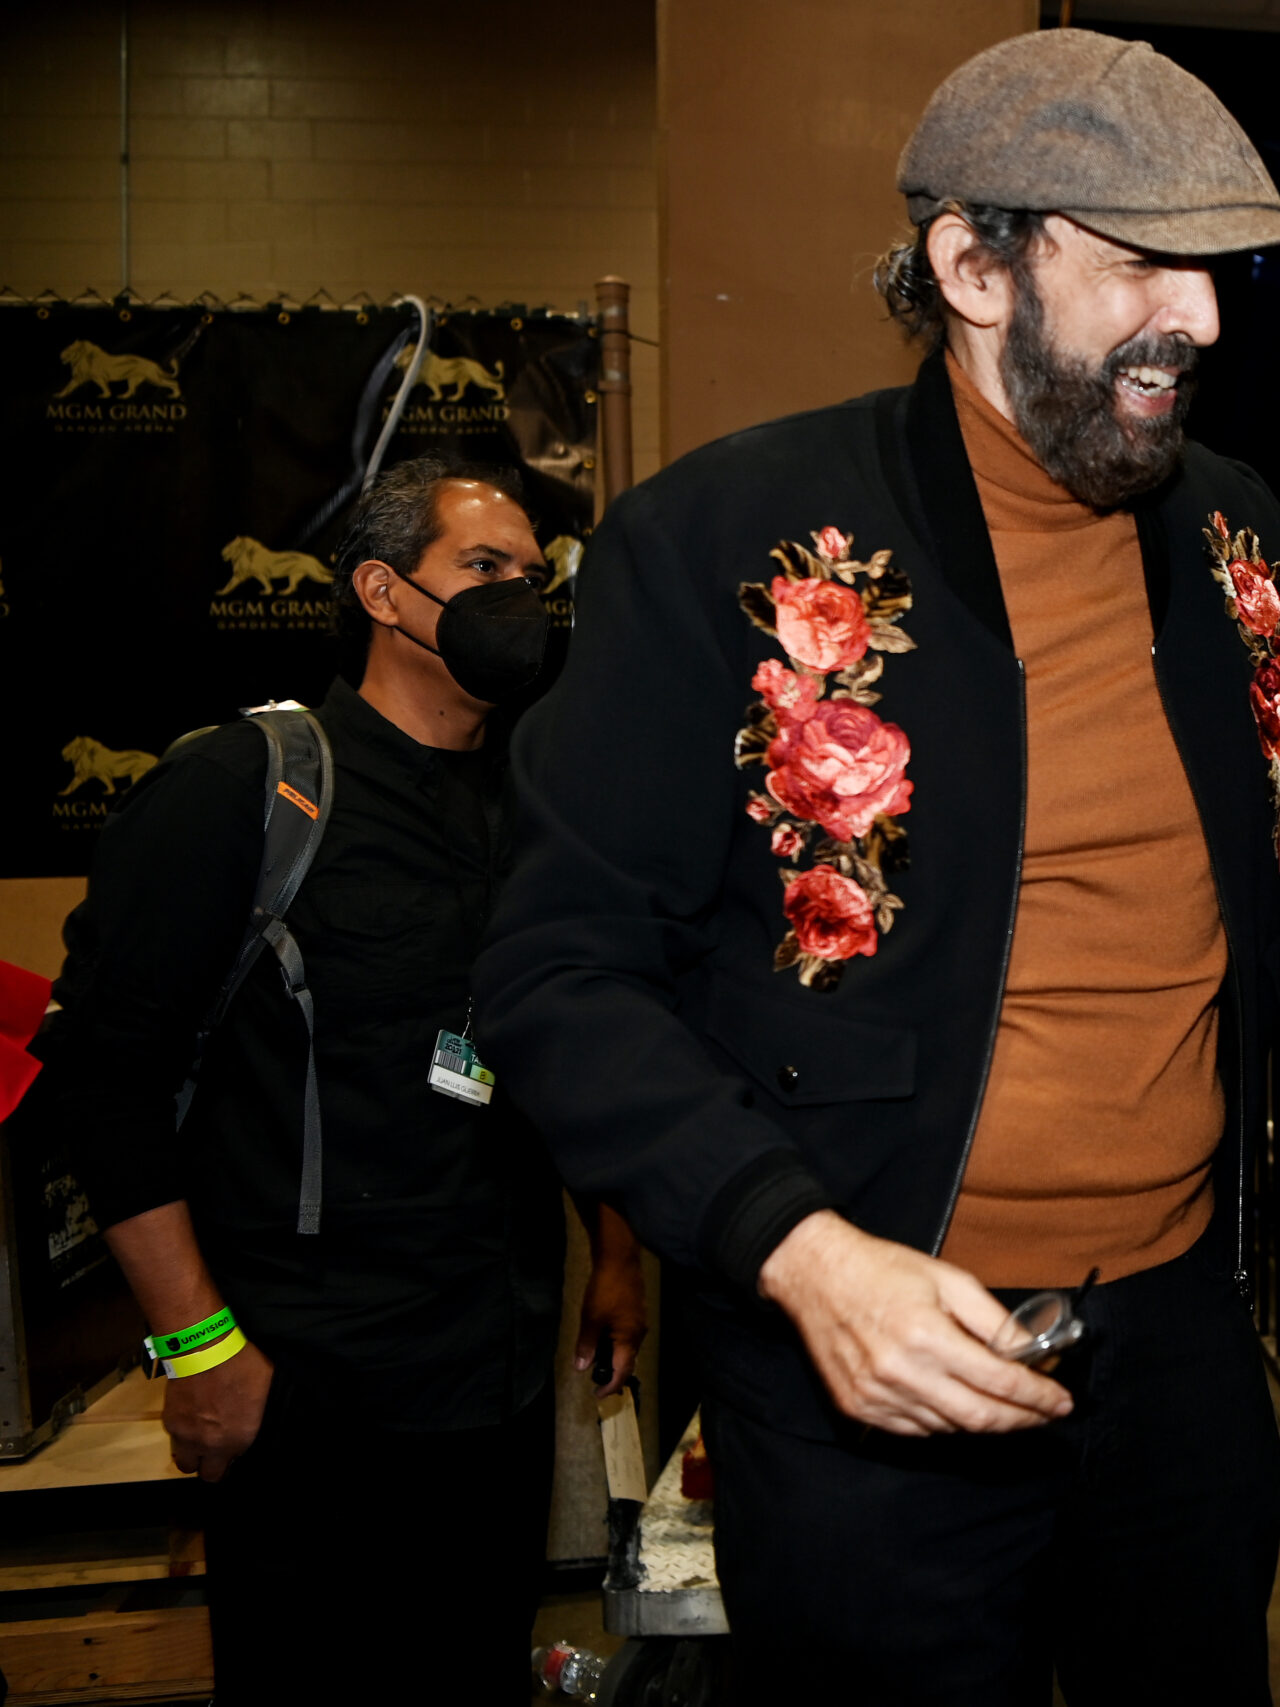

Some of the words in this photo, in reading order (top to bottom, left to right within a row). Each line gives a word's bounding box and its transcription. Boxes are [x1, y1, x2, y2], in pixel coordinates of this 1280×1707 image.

[46, 403, 103, 420] MGM
[109, 403, 187, 420] GRAND
[439, 405, 511, 421] GRAND
[209, 600, 265, 617] MGM
[52, 801, 108, 817] MGM
